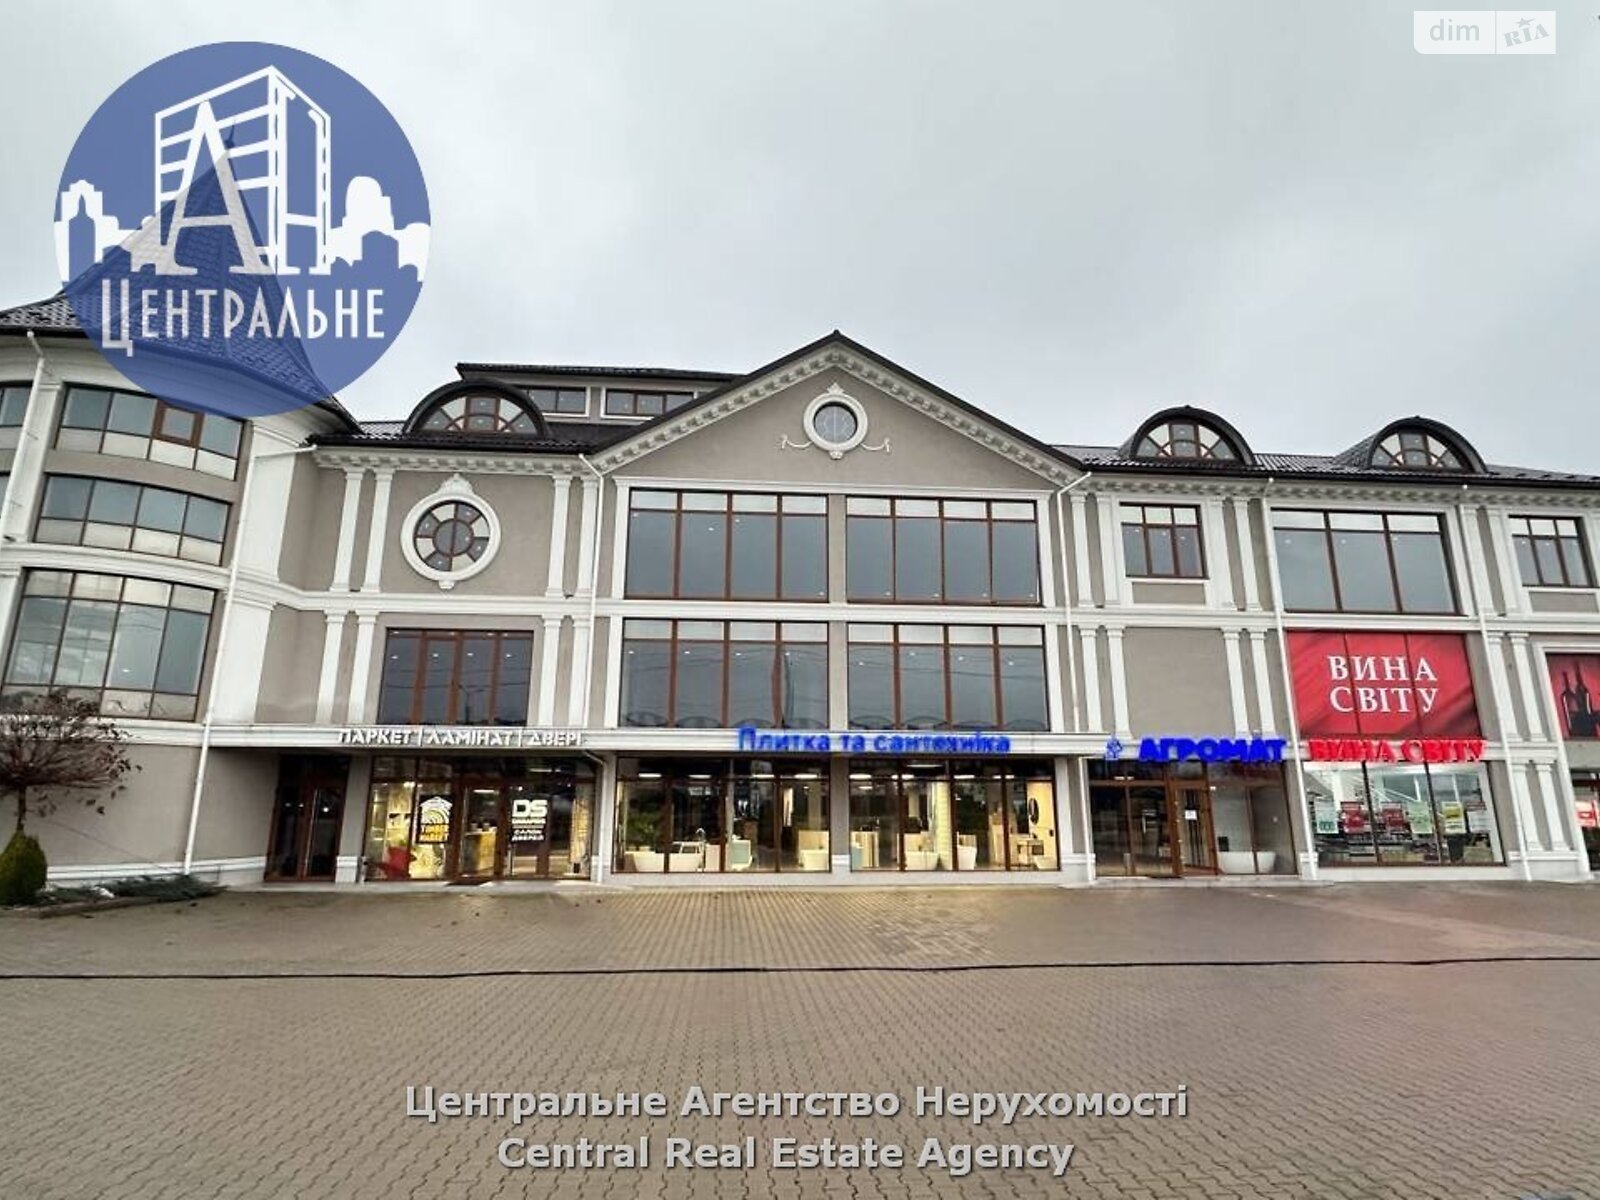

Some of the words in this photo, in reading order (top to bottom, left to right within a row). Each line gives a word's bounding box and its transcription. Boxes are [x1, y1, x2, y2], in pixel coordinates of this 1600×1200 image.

[1327, 656, 1438, 681] ВИНА
[1329, 686, 1439, 713] СВІТУ
[338, 729, 415, 745] ПАРКЕТ
[427, 730, 513, 746] ЛАМІНАТ
[527, 731, 582, 747] ДВЕРІ
[738, 726, 830, 752] Плитка
[840, 734, 865, 752] та
[873, 731, 1011, 754] сантехніка
[1138, 737, 1287, 763] АГРОМАТ
[1308, 738, 1397, 762] ВИНА
[1401, 738, 1486, 763] СВІТУ
[511, 799, 547, 817] DS
